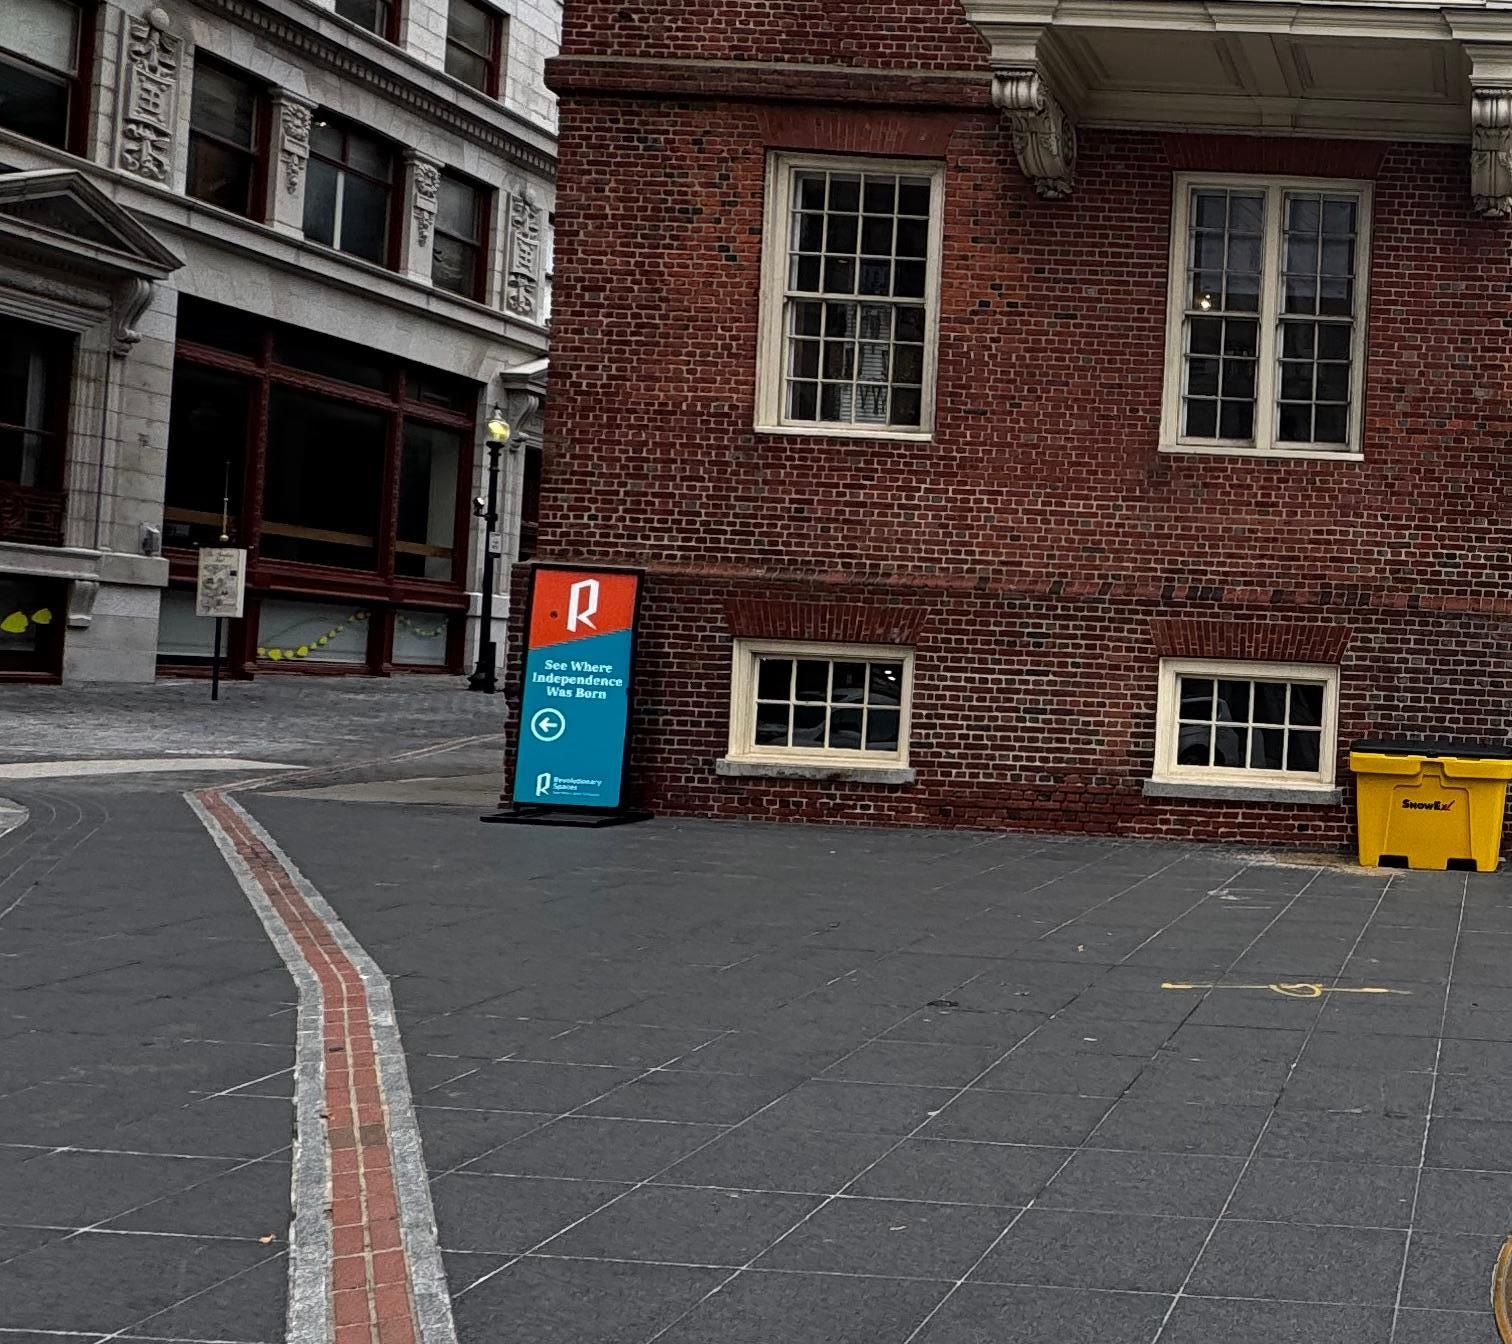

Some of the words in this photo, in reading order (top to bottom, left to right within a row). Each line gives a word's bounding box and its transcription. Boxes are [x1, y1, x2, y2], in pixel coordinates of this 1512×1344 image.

[566, 578, 600, 633] R
[545, 660, 567, 671] See
[570, 661, 613, 674] Where
[532, 672, 623, 687] Independence
[546, 686, 573, 698] Was
[575, 688, 607, 700] Born
[535, 772, 552, 797] R
[552, 783, 578, 791] Spaces
[553, 776, 602, 787] Revolutionary
